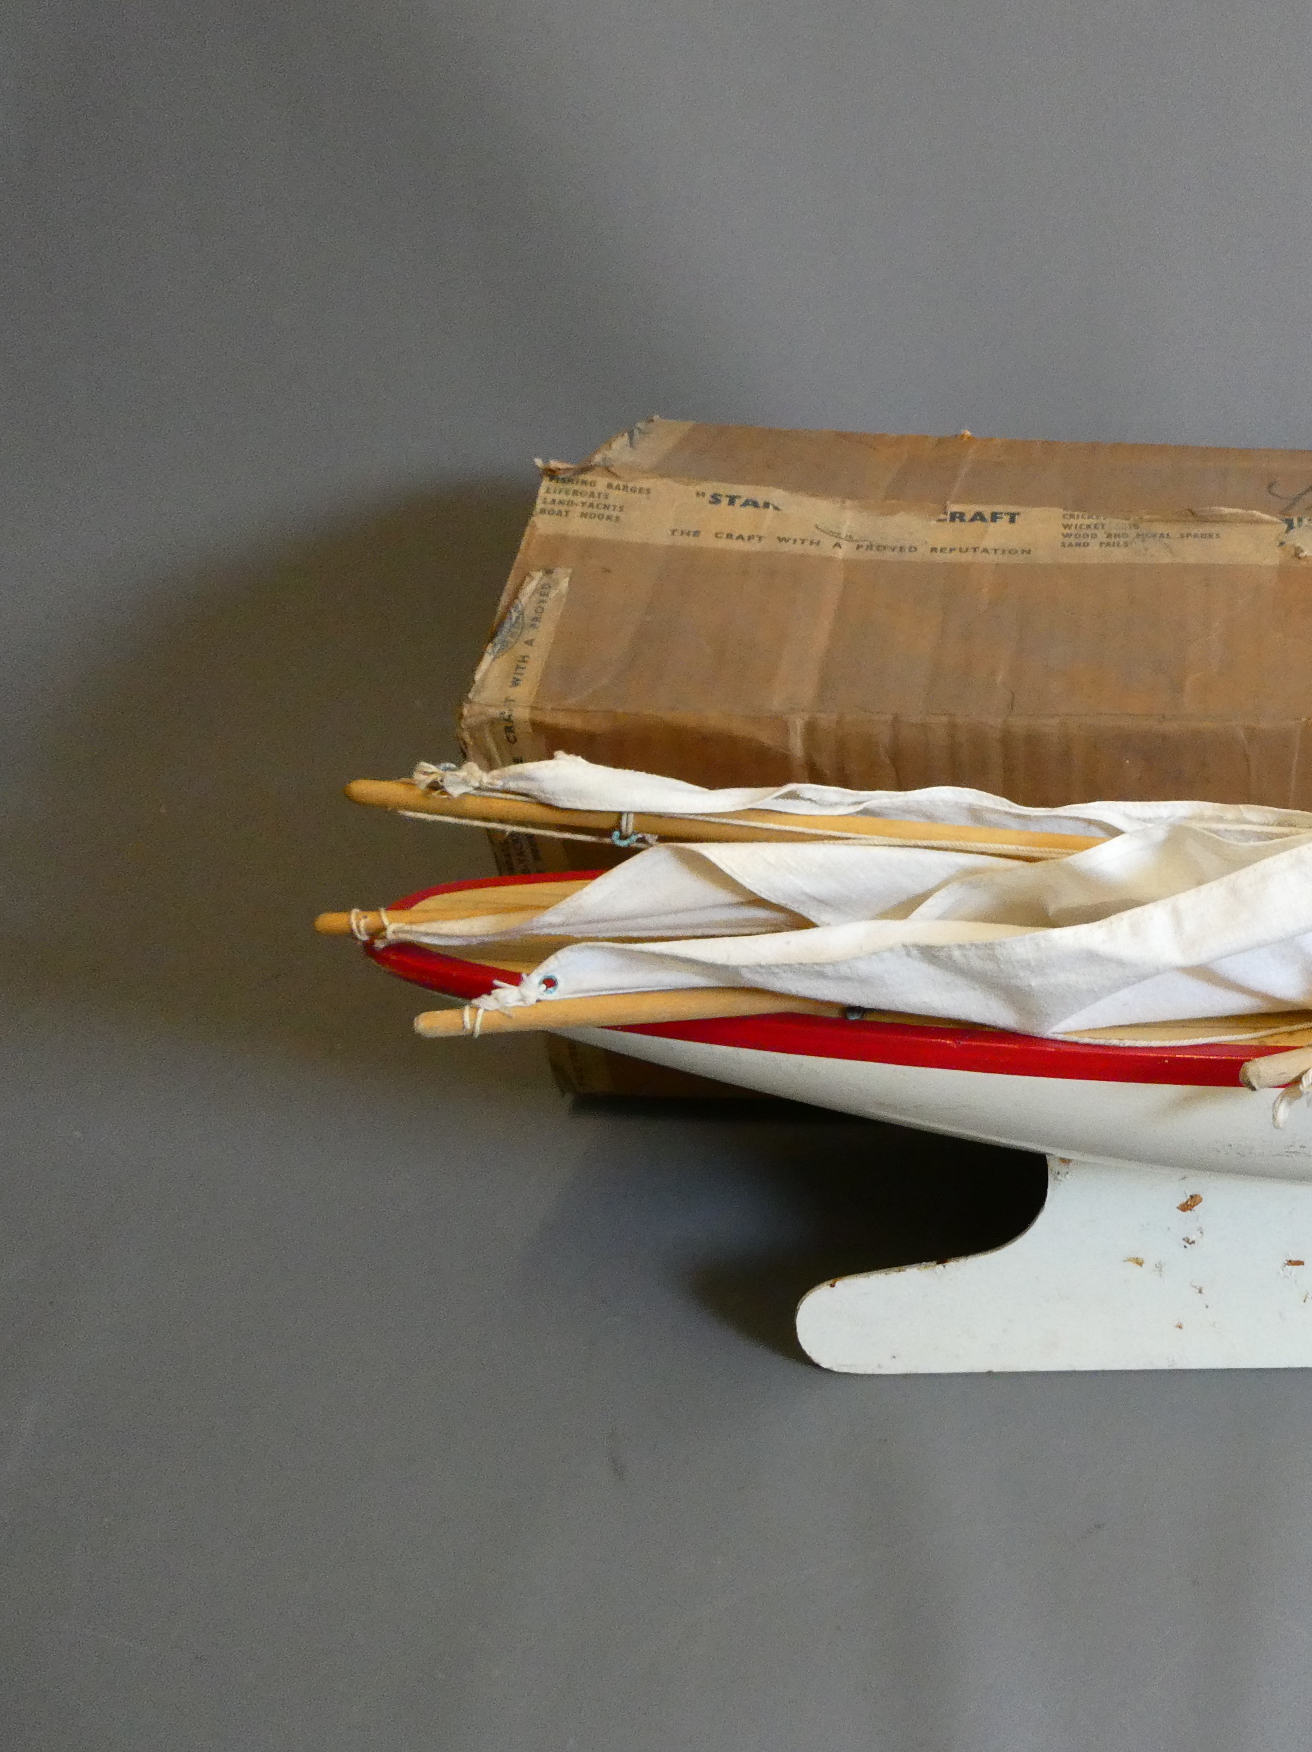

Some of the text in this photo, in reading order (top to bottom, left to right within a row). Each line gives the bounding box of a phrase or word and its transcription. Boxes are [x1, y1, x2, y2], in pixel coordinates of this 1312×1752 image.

[669, 528, 702, 539] THE
[714, 532, 766, 544] CRAFT
[776, 536, 821, 547] WITH
[832, 542, 843, 550] A
[929, 546, 1032, 556] REPUTATION
[1060, 541, 1091, 549] SAND
